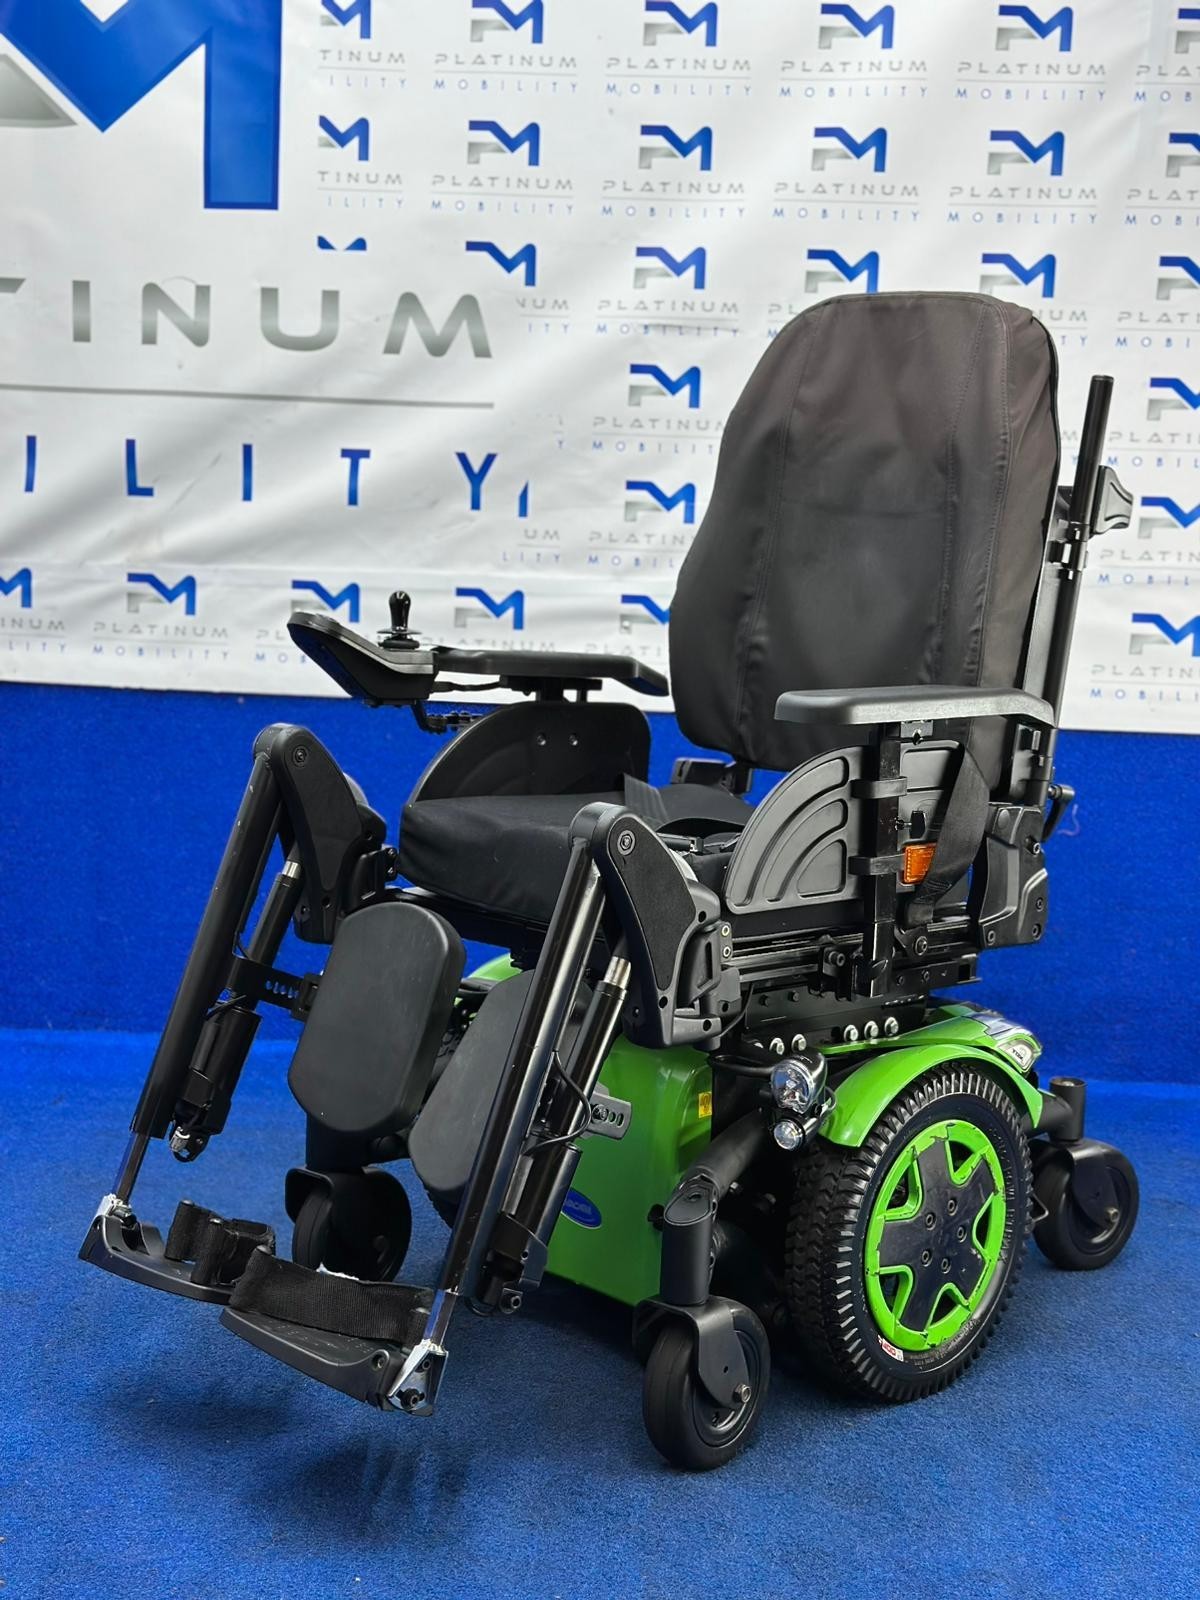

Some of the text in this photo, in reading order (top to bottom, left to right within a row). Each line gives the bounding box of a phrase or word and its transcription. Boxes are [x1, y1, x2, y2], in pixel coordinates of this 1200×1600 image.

[434, 53, 577, 68] PLATINUM
[606, 58, 751, 72] PLATINUM
[780, 60, 927, 73] PLATINUM
[957, 62, 1106, 76] PLATINUM
[433, 79, 577, 92] MOBILITY
[606, 83, 752, 96] MOBILITY
[779, 86, 928, 98] MOBILITY
[956, 87, 1106, 101] MOBILITY
[431, 174, 573, 190] PLATINUM
[602, 180, 745, 194] PLATINUM
[774, 182, 919, 197] PLATINUM
[949, 186, 1097, 200] PLATINUM
[431, 200, 573, 214] MOBILITY
[601, 205, 745, 218] MOBILITY
[772, 207, 920, 221] MOBILITY
[947, 212, 1097, 224] MOBILITY
[597, 300, 739, 314] PLATINUM
[596, 324, 739, 337] MOBILITY
[1109, 432, 1200, 444] PLATI
[94, 622, 228, 638] PLATINUM
[93, 645, 228, 658] MOBILITY
